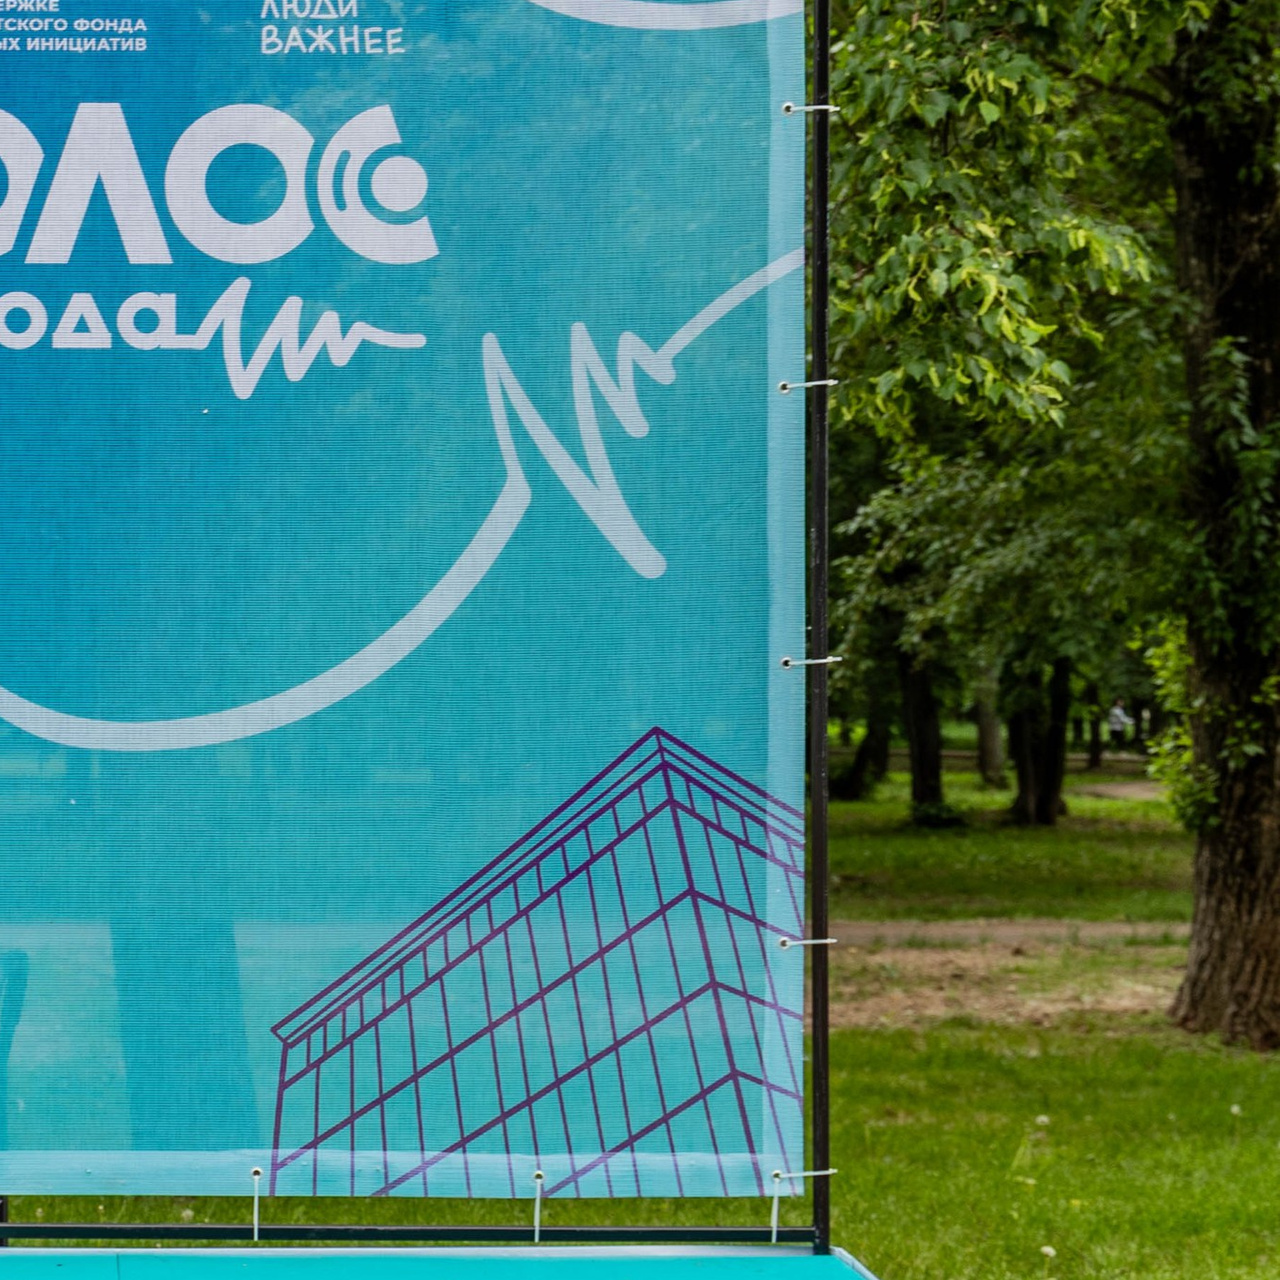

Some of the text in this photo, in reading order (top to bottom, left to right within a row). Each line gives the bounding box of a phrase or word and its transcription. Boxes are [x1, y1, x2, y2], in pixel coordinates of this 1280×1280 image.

[73, 17, 147, 33] ФОНДА
[26, 37, 147, 54] ИНИЦИАТИВ
[260, 24, 406, 55] ВАЖНЕЕ
